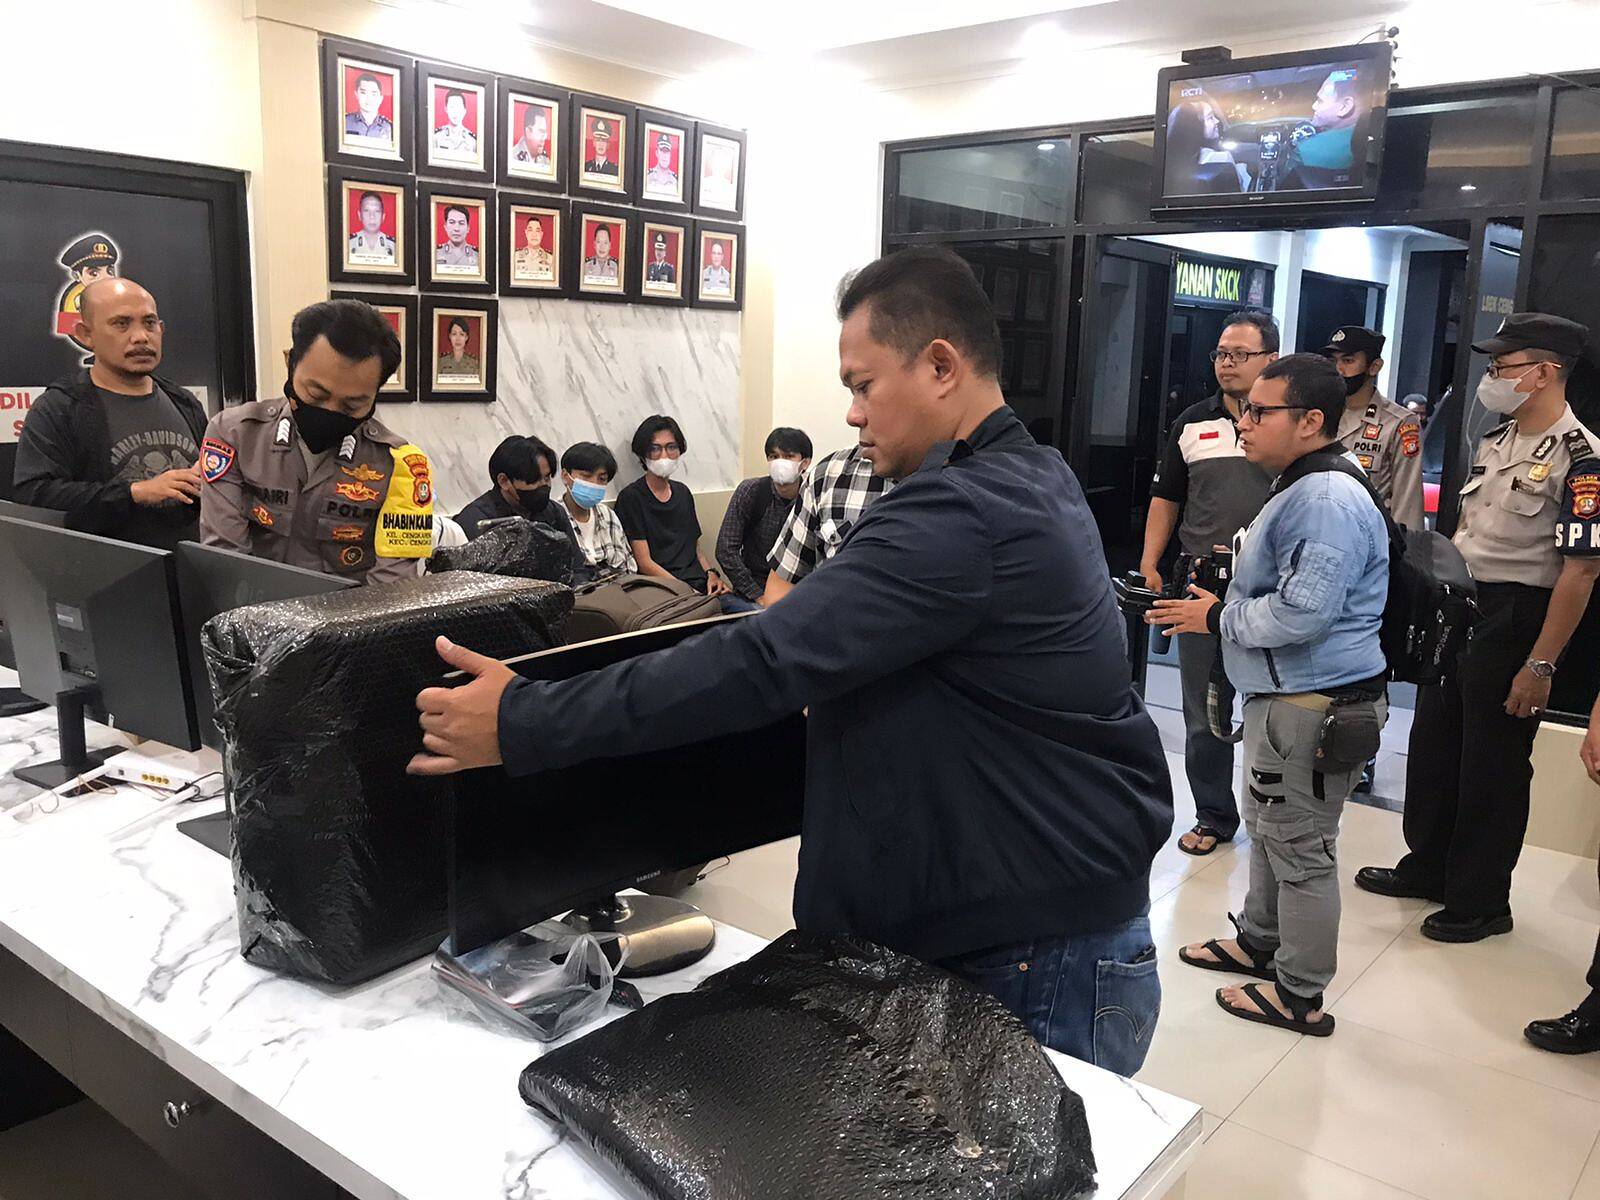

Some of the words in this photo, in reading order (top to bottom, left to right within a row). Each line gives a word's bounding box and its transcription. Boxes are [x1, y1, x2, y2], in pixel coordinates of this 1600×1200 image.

[1181, 88, 1202, 97] RCTI
[1175, 261, 1213, 298] YANAN
[1215, 266, 1240, 300] SKCK
[110, 430, 195, 465] HARLEY-DAVIDSON
[1354, 442, 1381, 452] POLRI
